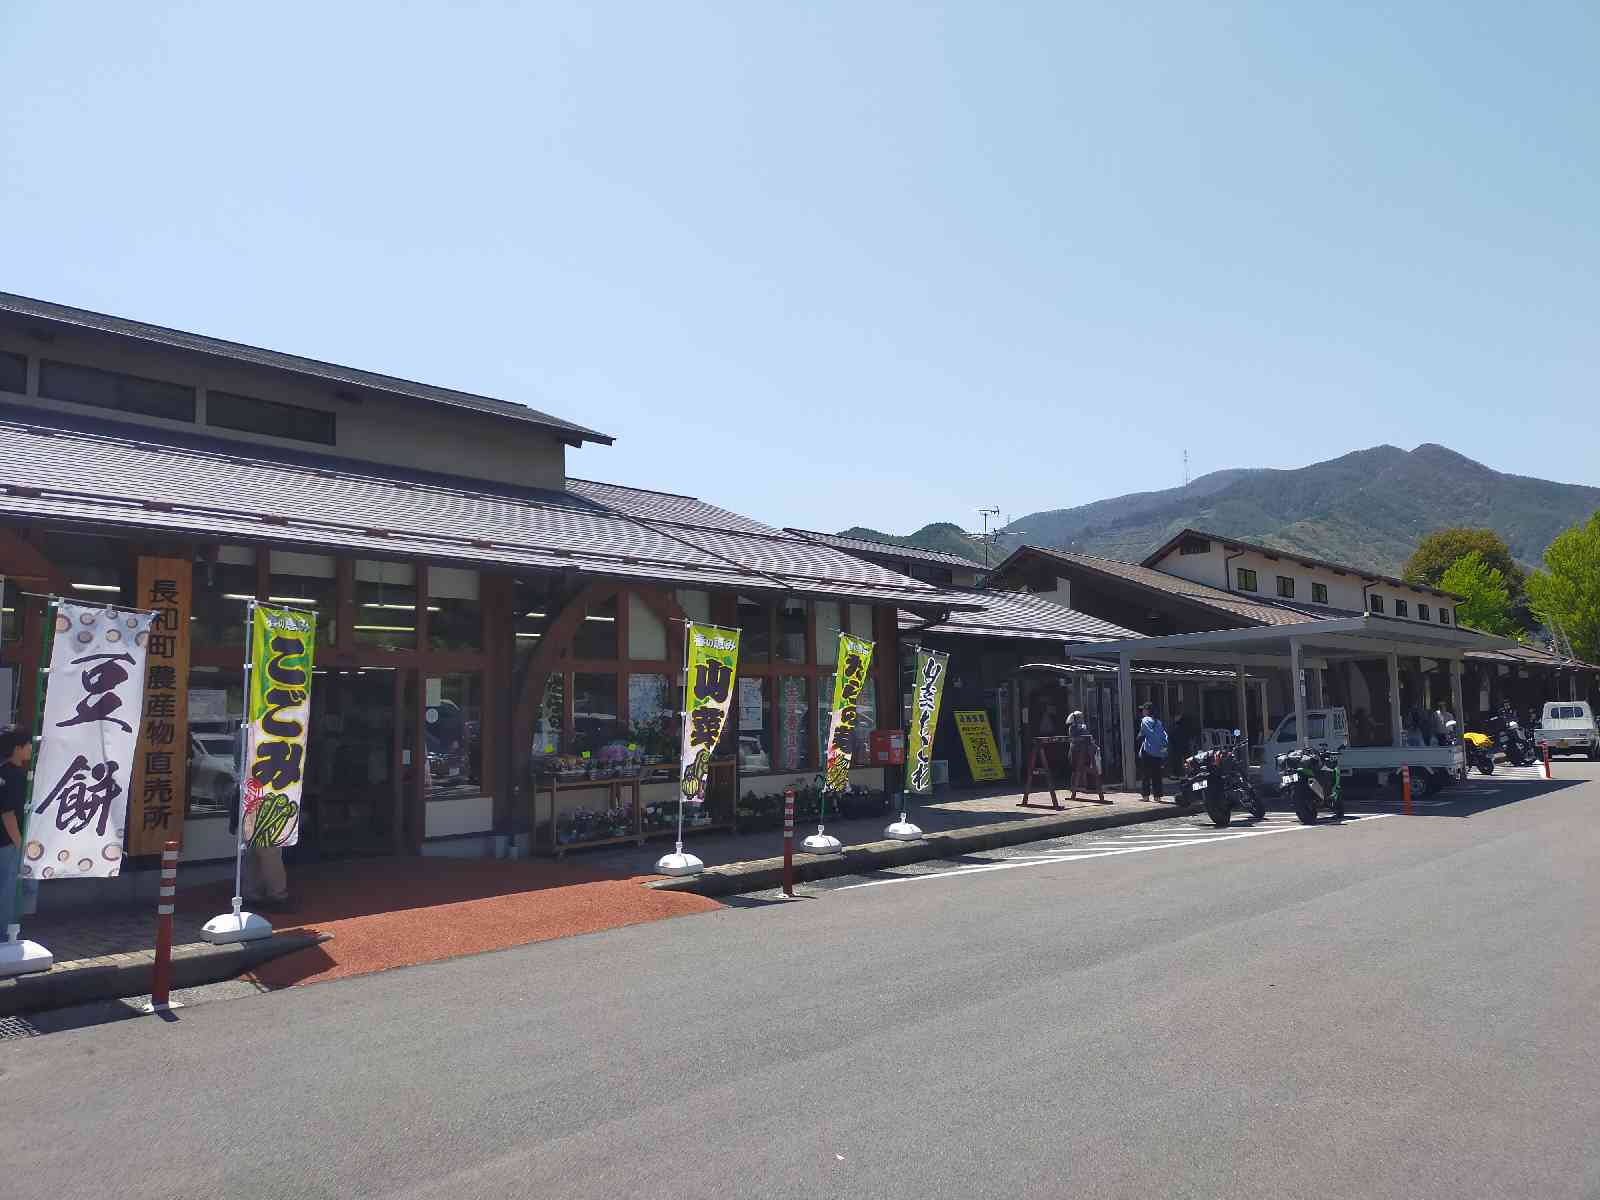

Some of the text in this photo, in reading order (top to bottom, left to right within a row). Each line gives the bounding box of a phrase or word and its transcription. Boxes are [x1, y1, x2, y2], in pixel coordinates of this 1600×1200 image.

[35, 652, 137, 837] 豆餅
[143, 579, 179, 833] 長和町農産物直売所
[252, 635, 307, 791] こごみ
